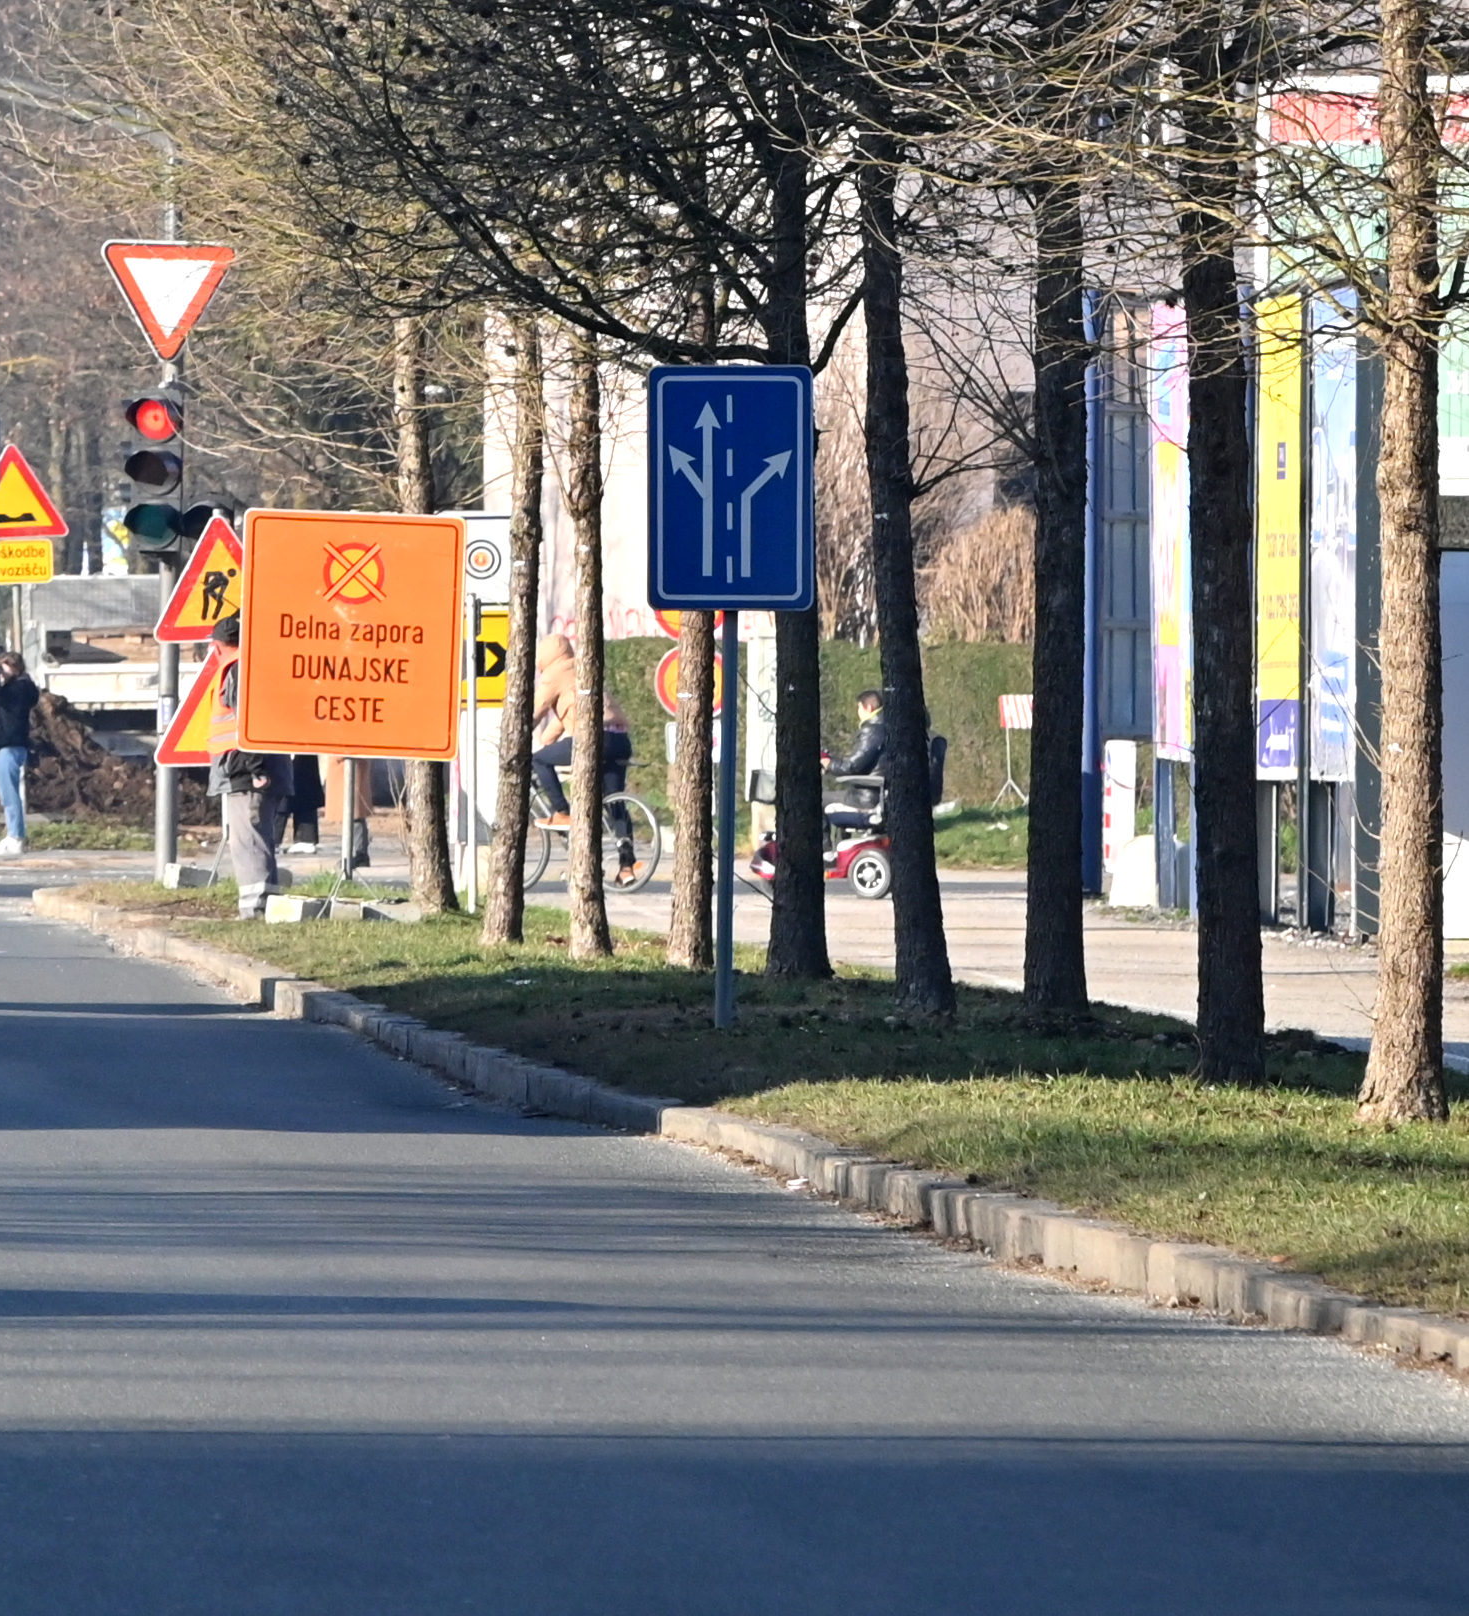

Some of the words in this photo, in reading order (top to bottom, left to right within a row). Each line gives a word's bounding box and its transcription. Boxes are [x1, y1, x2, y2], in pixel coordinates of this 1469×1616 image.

[0, 565, 47, 577] vozišču
[280, 613, 340, 640] Delna
[350, 623, 424, 649] zapora
[292, 654, 410, 684] DUNAJSKE
[314, 695, 385, 723] CESTE
